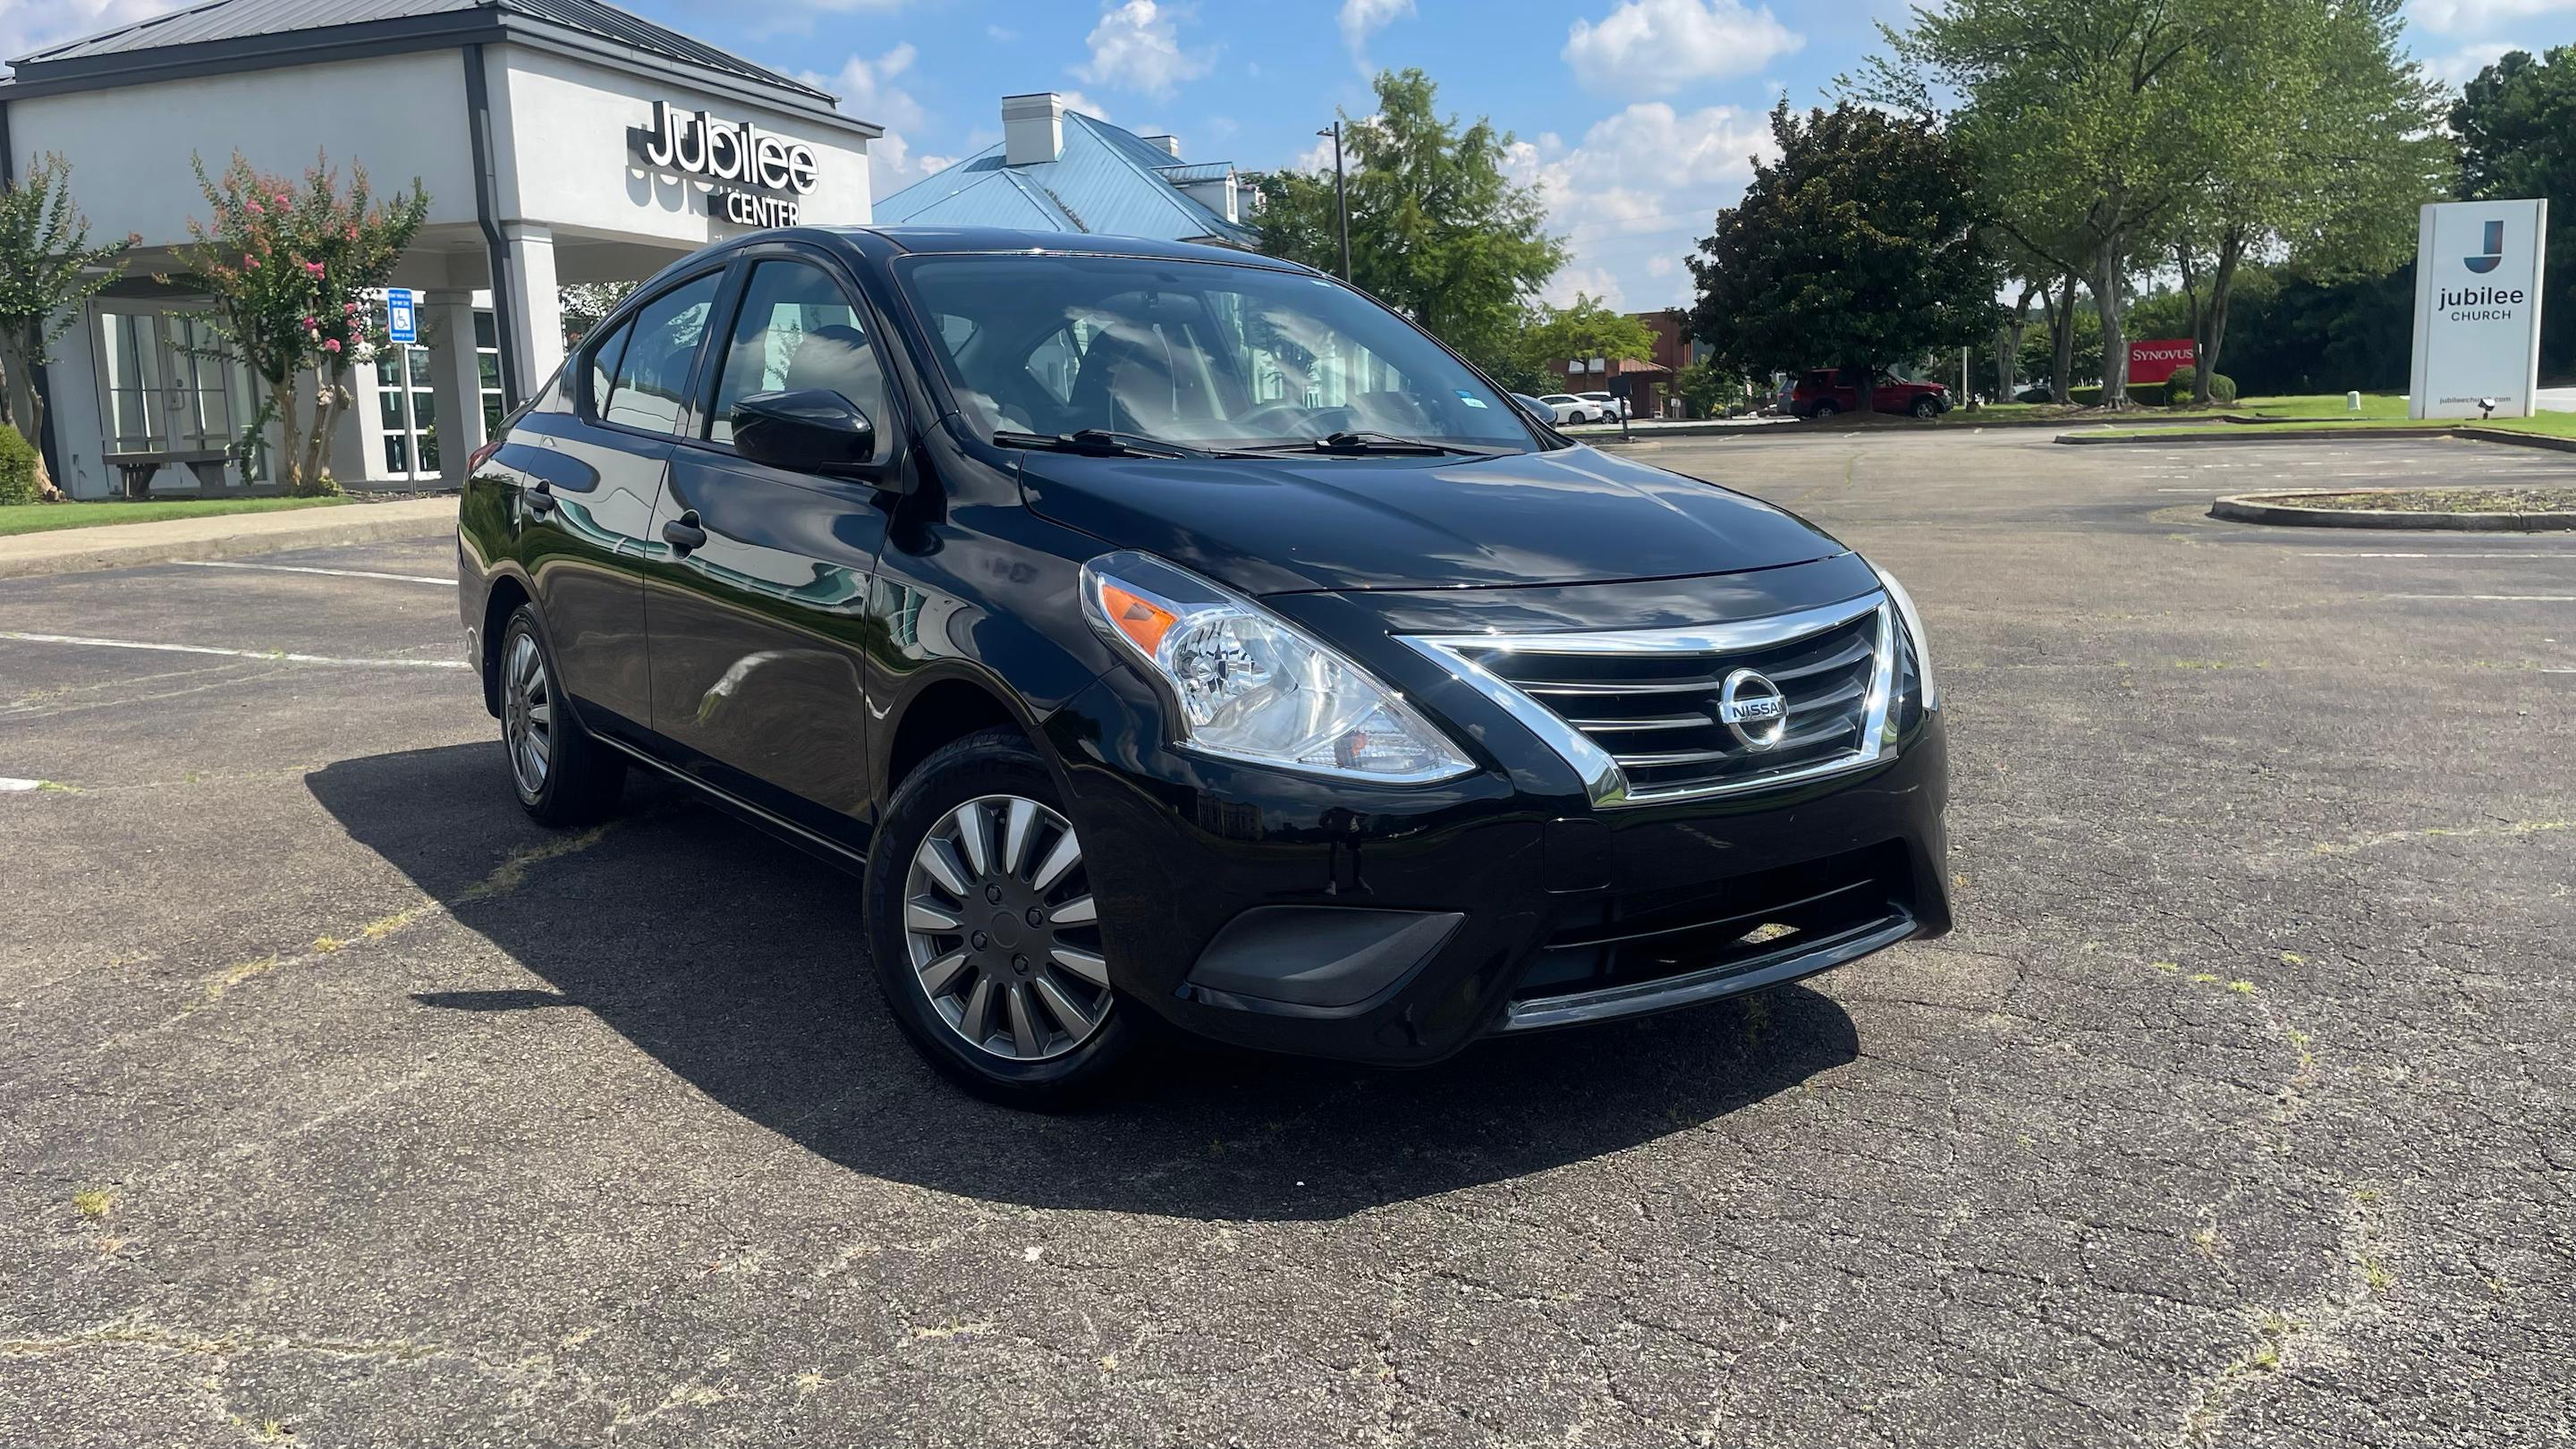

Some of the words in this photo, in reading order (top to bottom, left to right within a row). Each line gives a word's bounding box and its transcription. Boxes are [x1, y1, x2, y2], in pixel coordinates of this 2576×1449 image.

[648, 101, 818, 195] Jubilee
[726, 192, 800, 227] CENTER
[2438, 287, 2523, 311] jubilee
[2451, 310, 2512, 322] CHURCH
